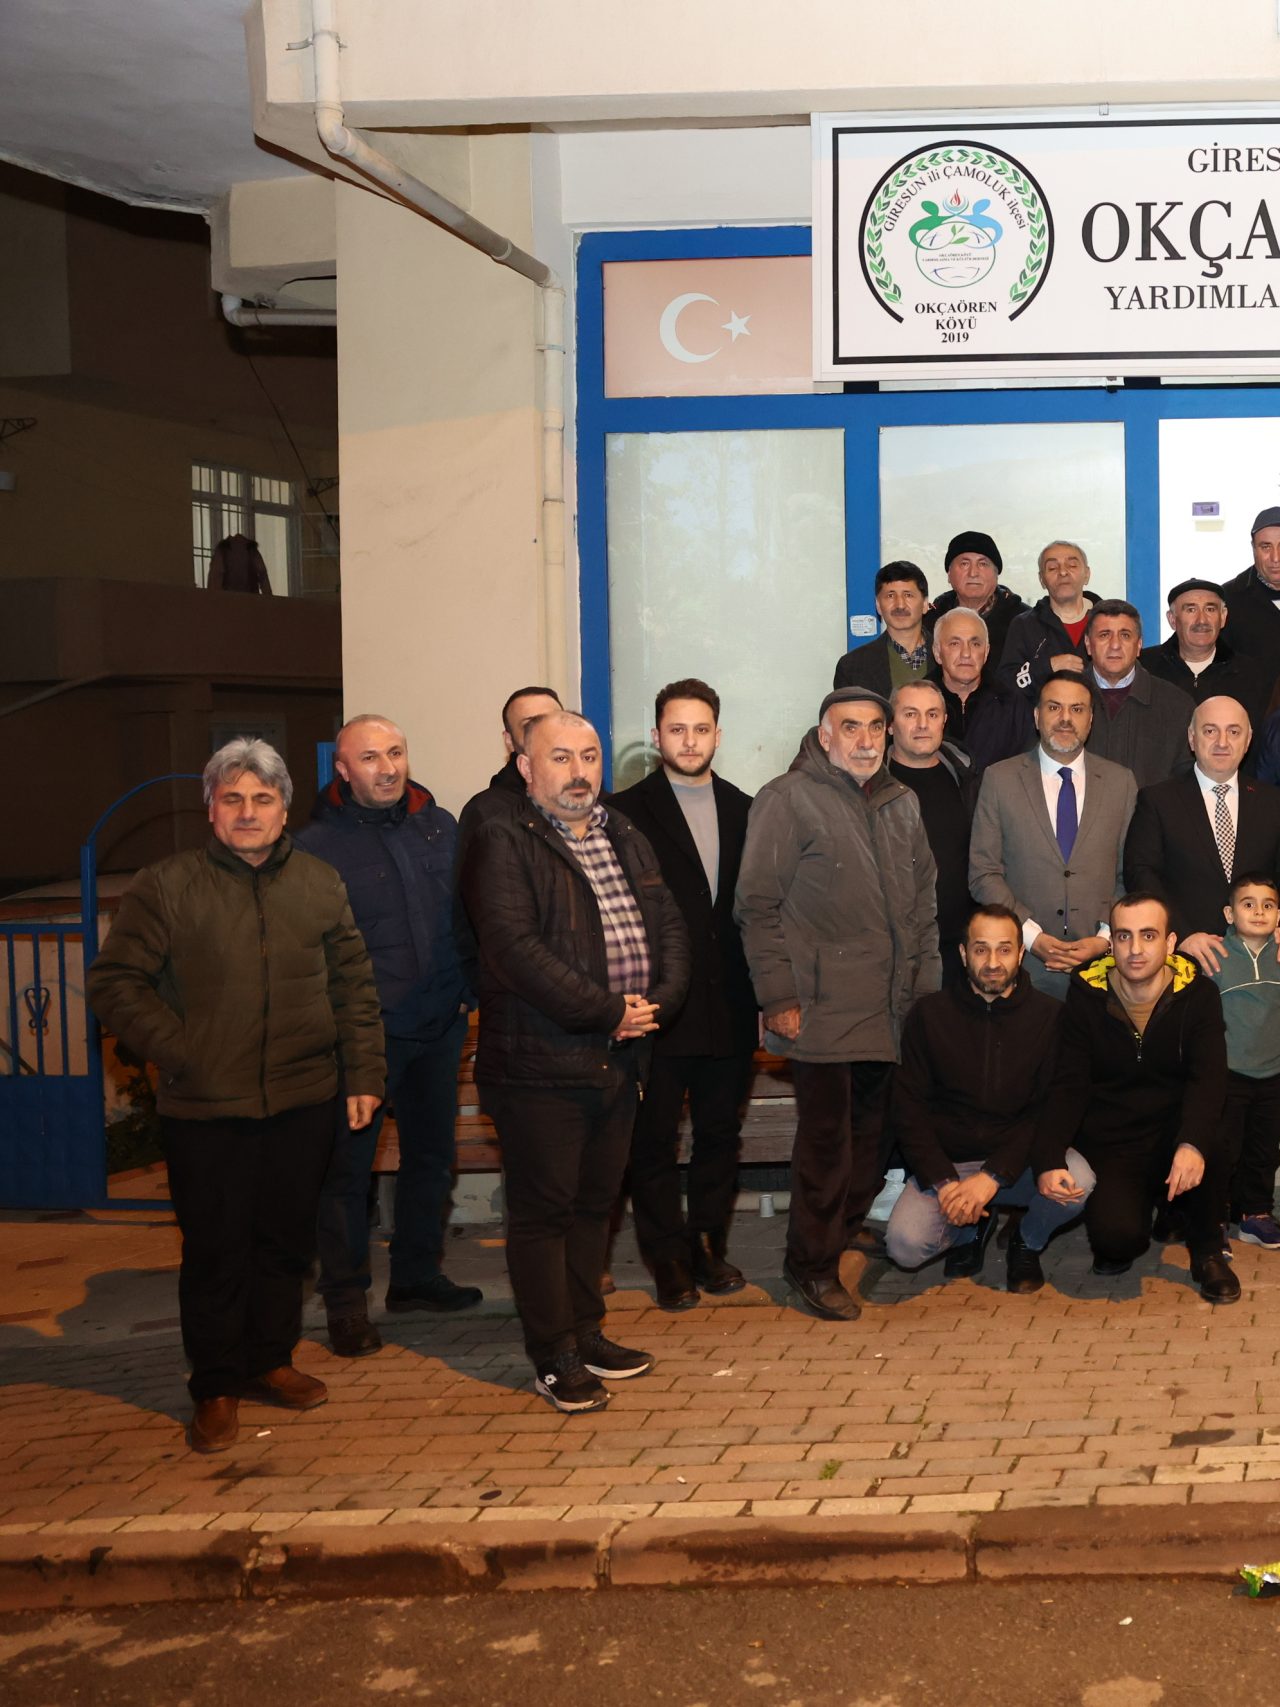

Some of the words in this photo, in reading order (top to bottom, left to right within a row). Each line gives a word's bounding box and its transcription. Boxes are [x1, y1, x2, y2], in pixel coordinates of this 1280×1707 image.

[884, 179, 927, 232] GİRESUN
[943, 166, 1012, 202] ÇAMOLUK
[1007, 199, 1027, 230] ilçesi
[914, 299, 997, 316] OKÇAÖREN
[935, 315, 977, 330] KÖYÜ
[941, 332, 969, 343] 2019
